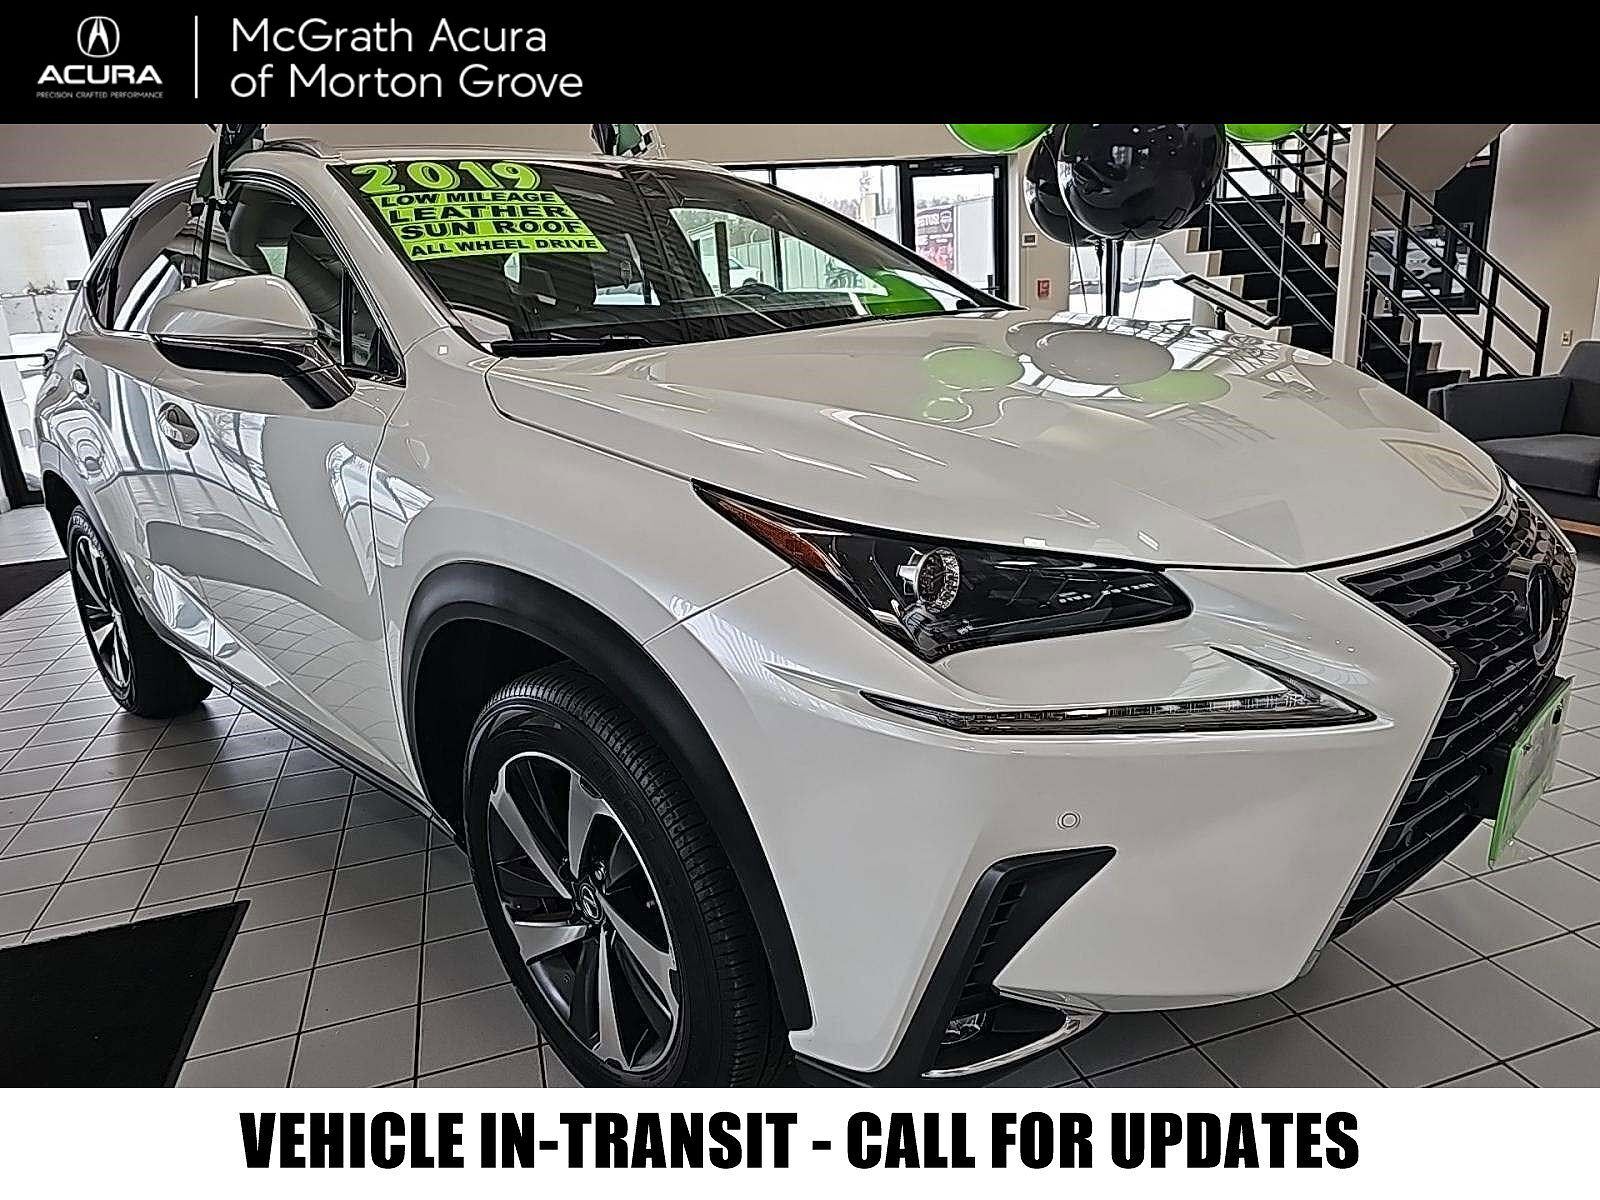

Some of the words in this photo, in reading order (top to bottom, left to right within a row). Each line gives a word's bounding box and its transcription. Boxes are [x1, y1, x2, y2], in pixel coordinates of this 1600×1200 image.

[351, 161, 541, 194] 2019
[381, 192, 441, 208] LOW
[446, 191, 556, 204] MILEAGE
[388, 205, 576, 224] LEATHER
[401, 222, 476, 240] SUN
[493, 219, 584, 235] ROOF
[411, 243, 453, 256] ALL
[456, 238, 531, 251] WHEEL
[536, 237, 599, 249] DRIVE
